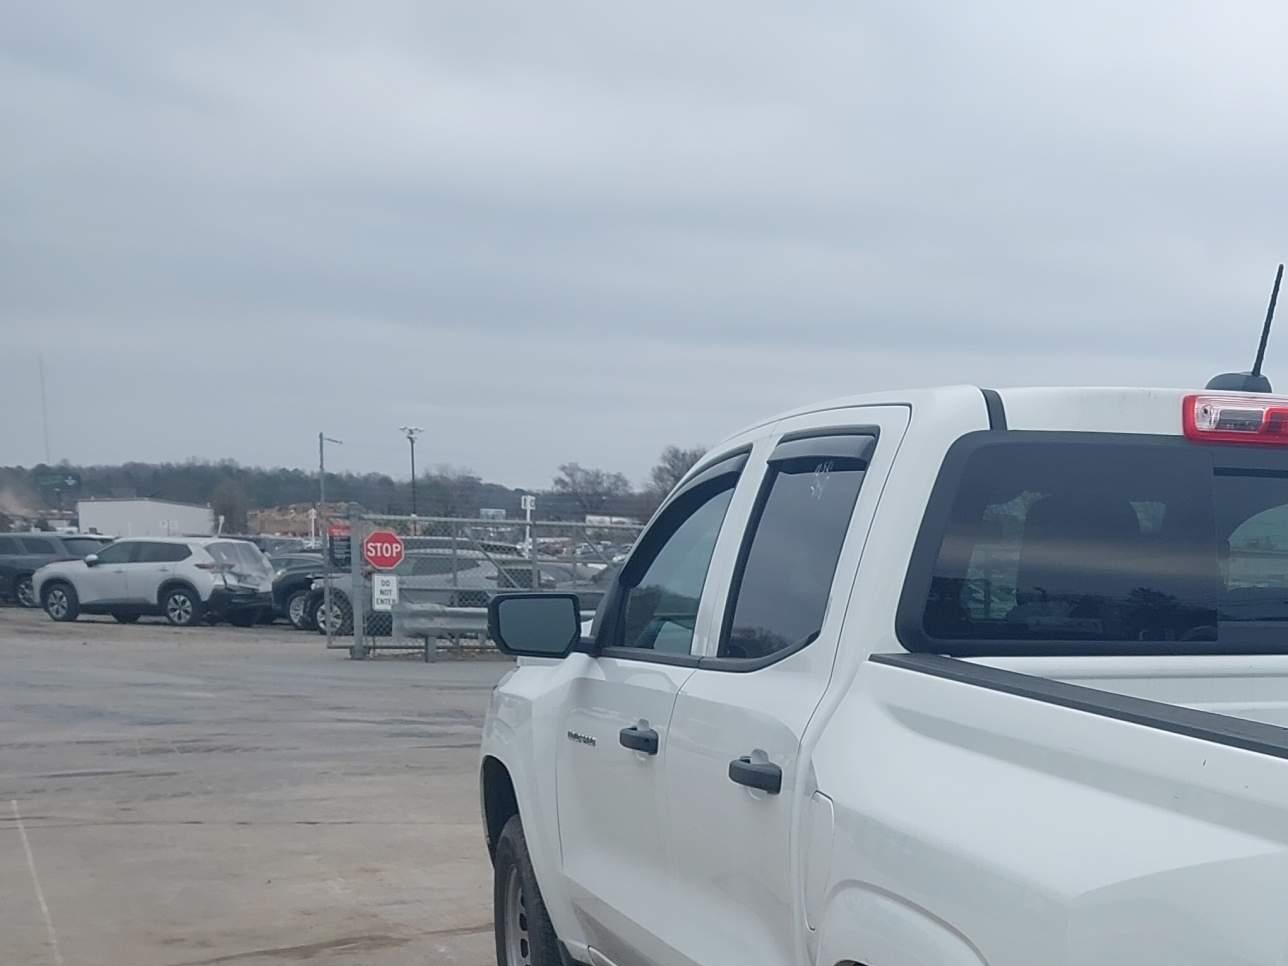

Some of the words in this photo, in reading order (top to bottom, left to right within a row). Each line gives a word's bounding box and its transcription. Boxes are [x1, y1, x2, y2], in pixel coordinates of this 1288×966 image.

[367, 542, 401, 558] STOP
[380, 579, 391, 587] DO
[379, 589, 392, 597] NOT
